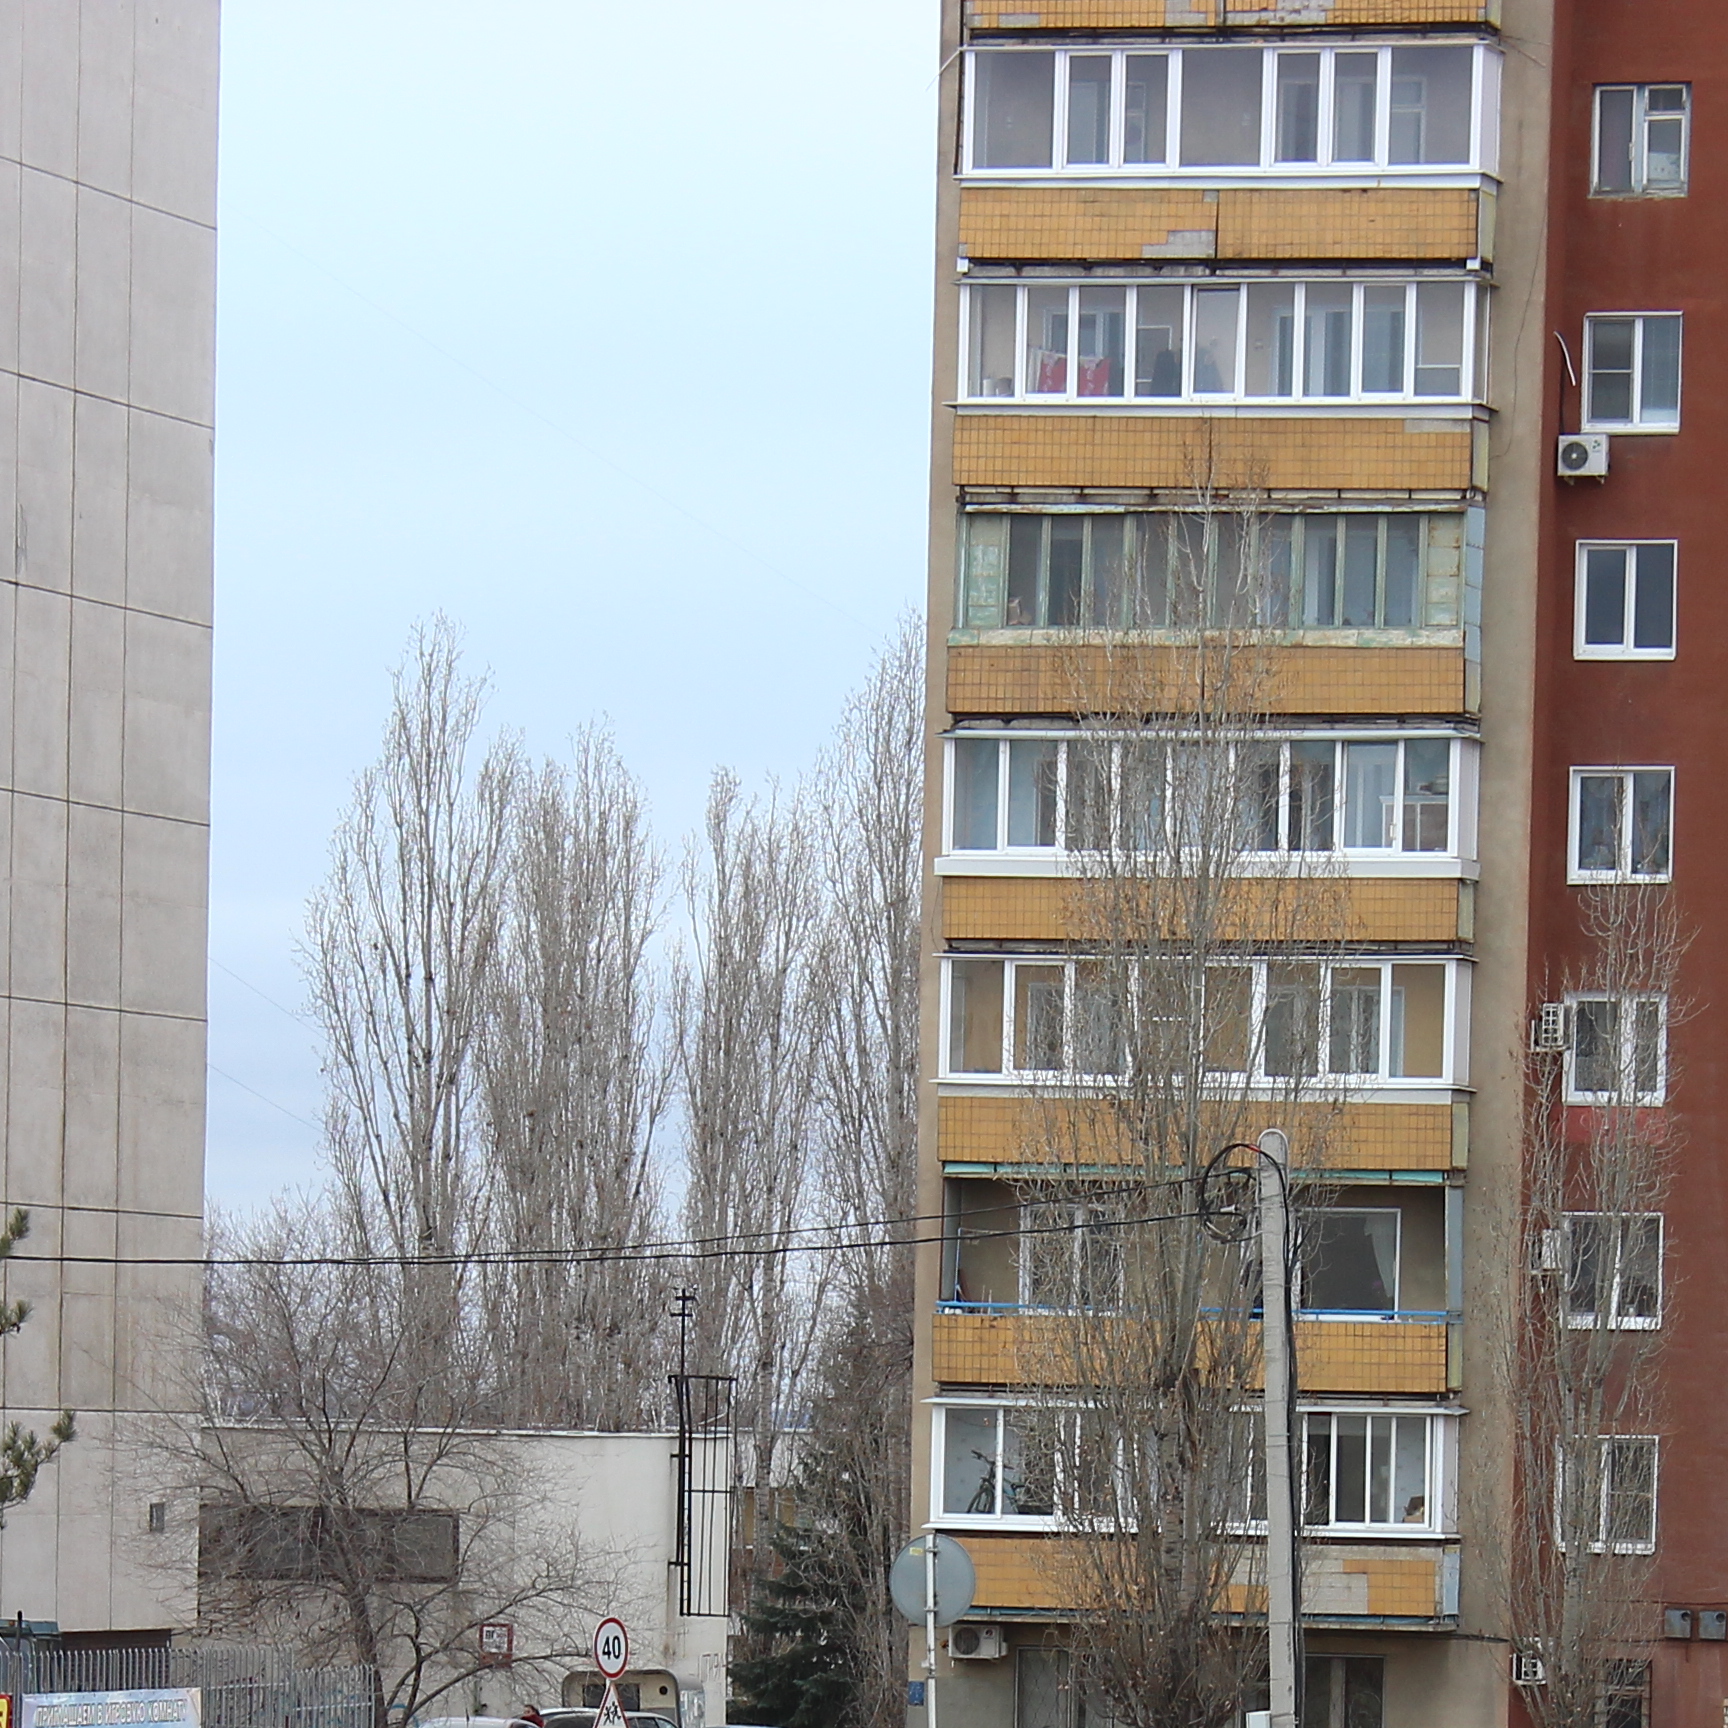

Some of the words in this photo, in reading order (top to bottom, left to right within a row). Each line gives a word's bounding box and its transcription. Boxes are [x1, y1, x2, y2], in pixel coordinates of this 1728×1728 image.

[602, 1635, 621, 1660] 40
[35, 1702, 95, 1728] ПРИГЛАШАЕМ
[97, 1704, 103, 1726] В
[105, 1701, 146, 1725] ИГРОВУЮ
